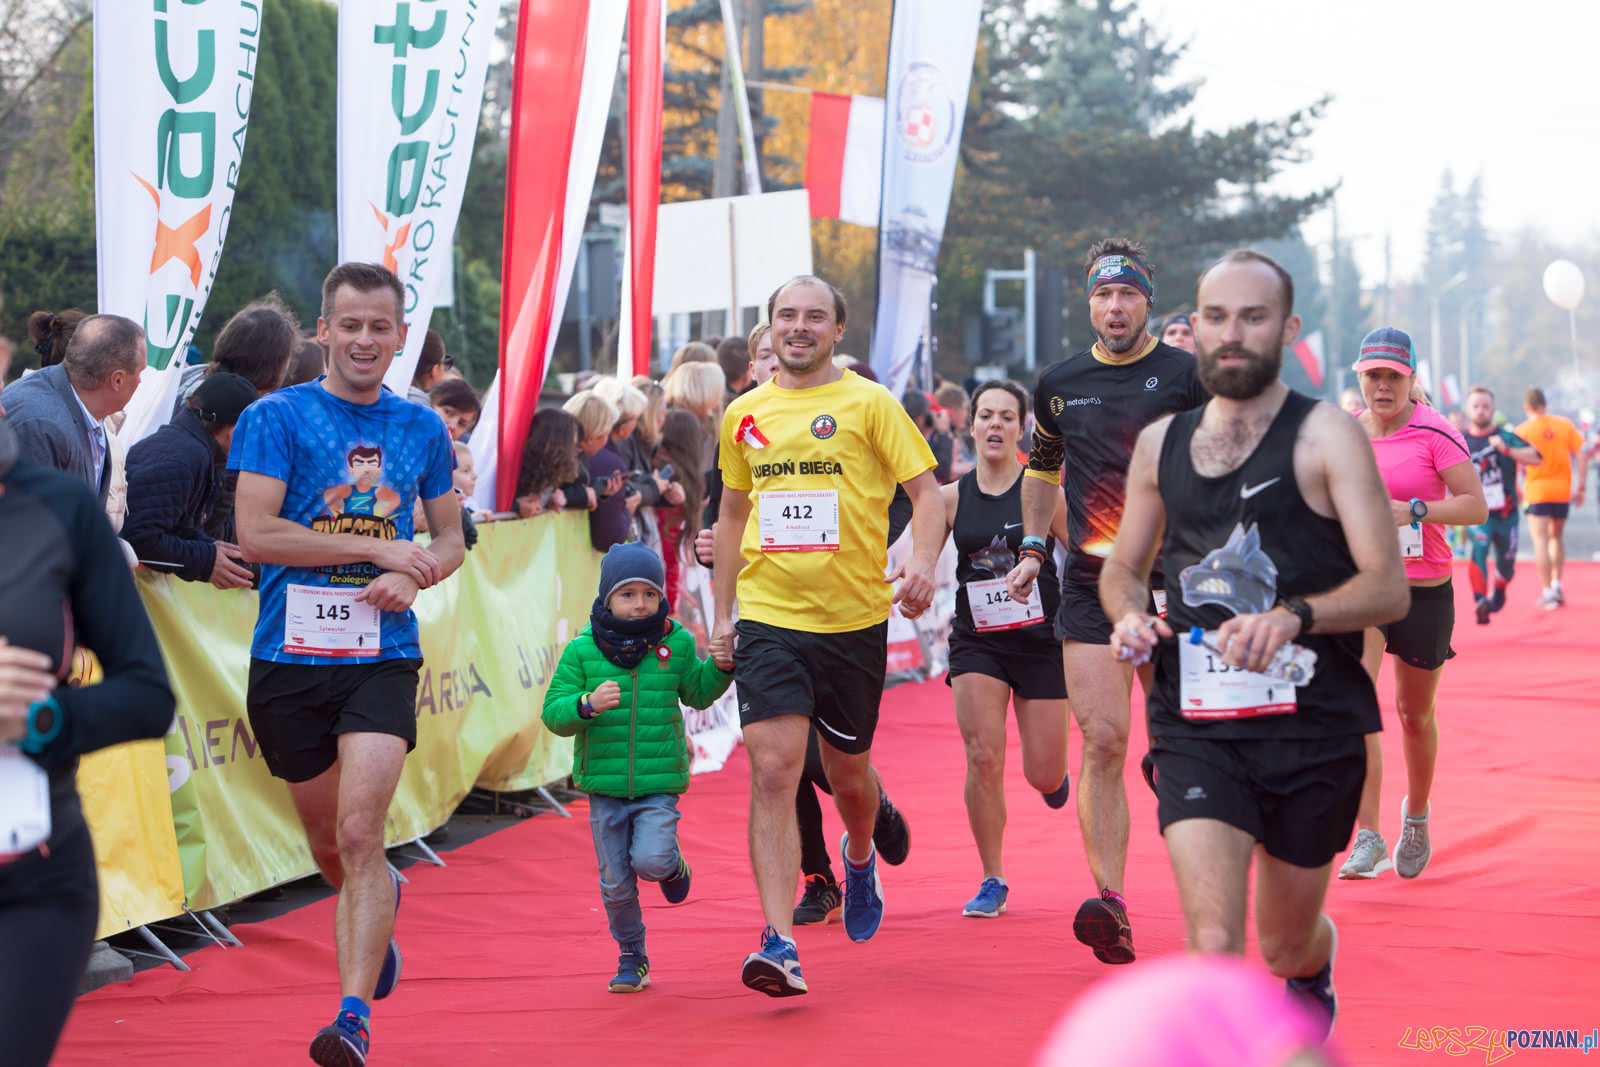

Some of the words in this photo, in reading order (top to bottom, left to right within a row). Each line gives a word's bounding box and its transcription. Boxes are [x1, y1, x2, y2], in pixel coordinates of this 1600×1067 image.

[128, 0, 216, 371] exac
[1066, 397, 1102, 407] metalpress
[799, 461, 844, 476] BIEGA
[782, 505, 813, 519] 412
[316, 604, 350, 621] 145
